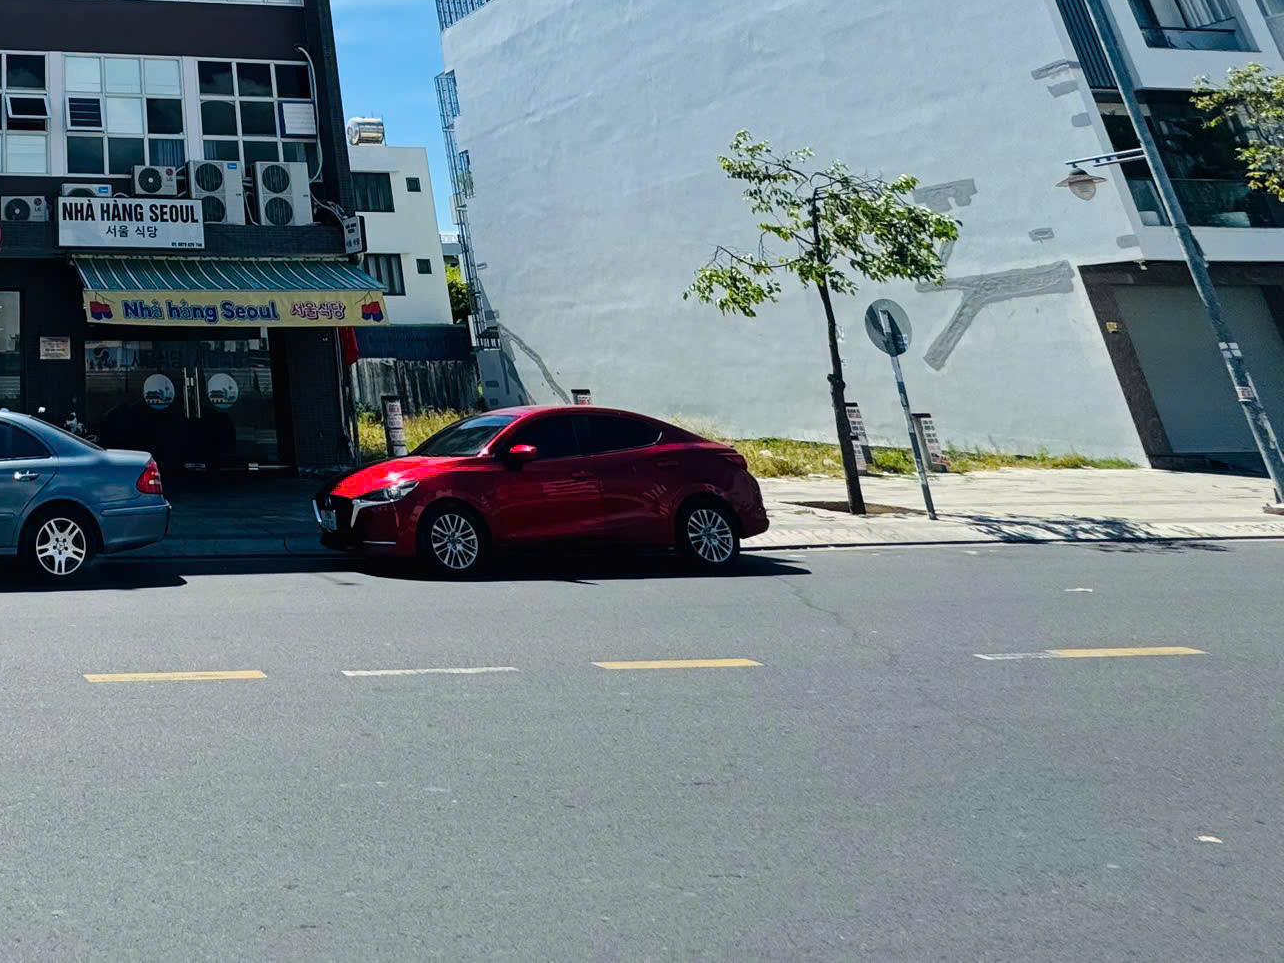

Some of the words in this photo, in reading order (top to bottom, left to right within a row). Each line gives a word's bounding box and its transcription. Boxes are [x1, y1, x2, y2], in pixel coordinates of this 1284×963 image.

[62, 199, 95, 221] NHÀ
[100, 200, 144, 222] HÀNG
[149, 204, 198, 223] SEOUL
[105, 225, 129, 238] 서울
[134, 225, 158, 238] 식당
[220, 299, 281, 321] Seoul
